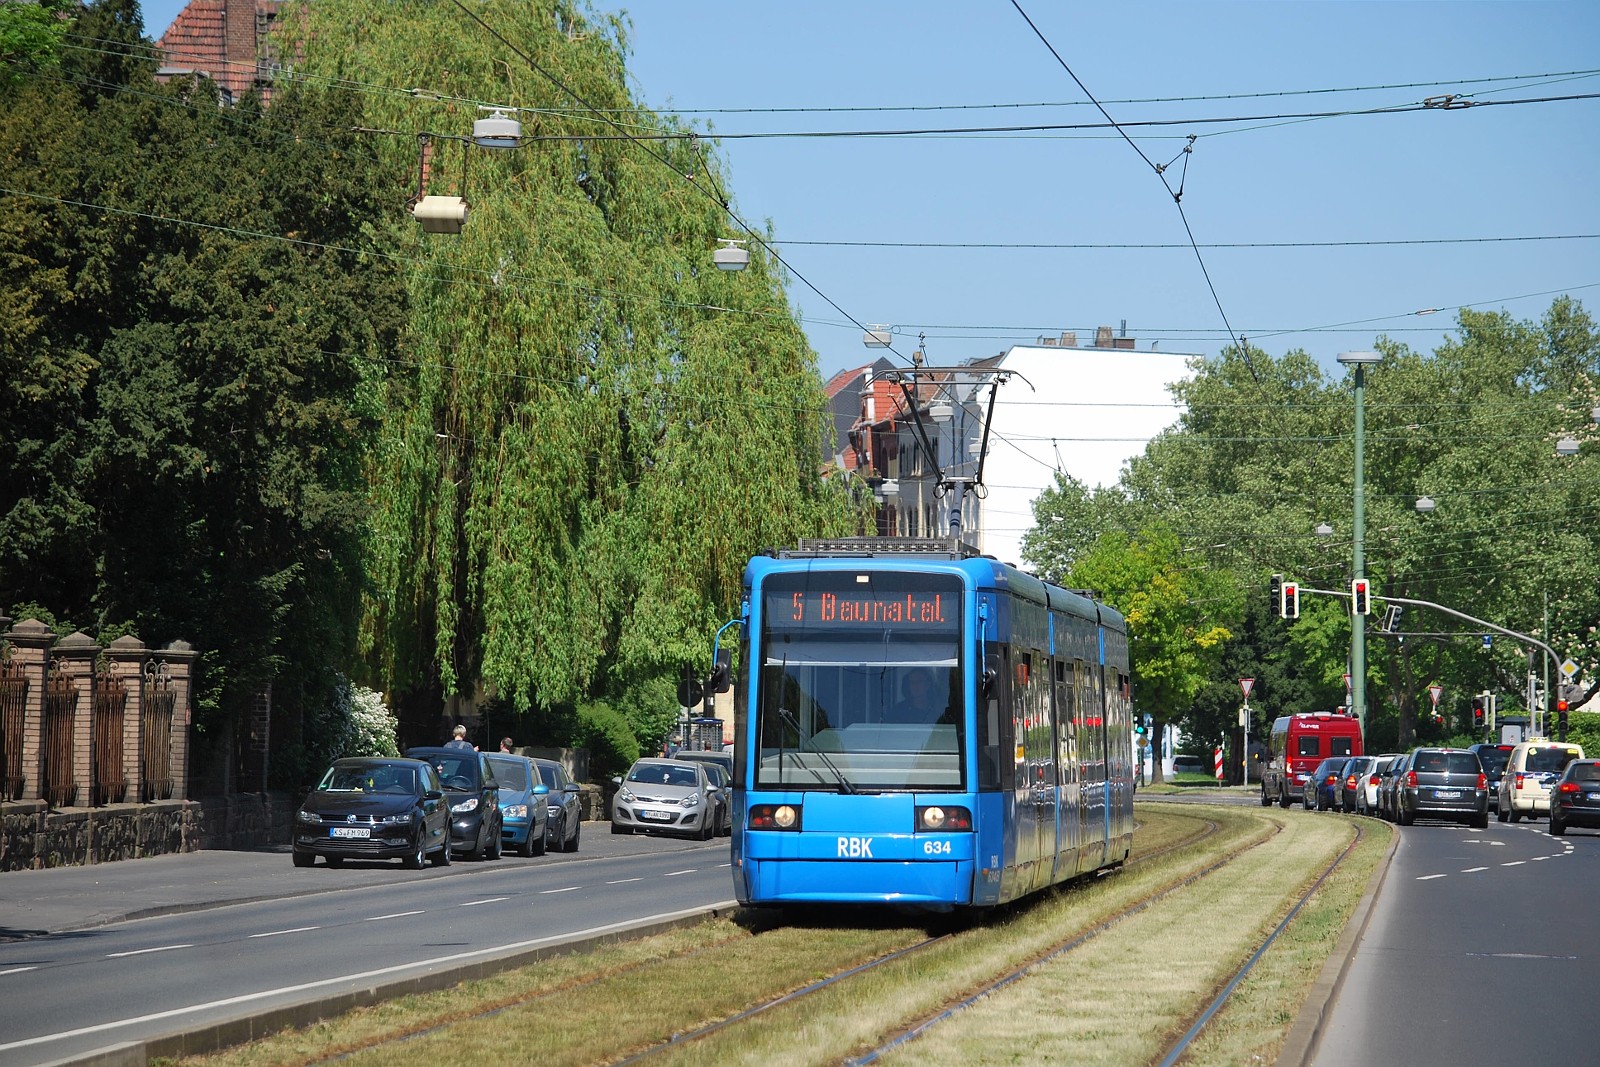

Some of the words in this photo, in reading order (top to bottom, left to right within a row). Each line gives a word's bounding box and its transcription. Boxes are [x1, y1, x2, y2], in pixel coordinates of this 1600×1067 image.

[793, 592, 803, 621] 5
[820, 592, 945, 622] Baunatal
[837, 837, 873, 858] RBK
[923, 841, 951, 854] 634
